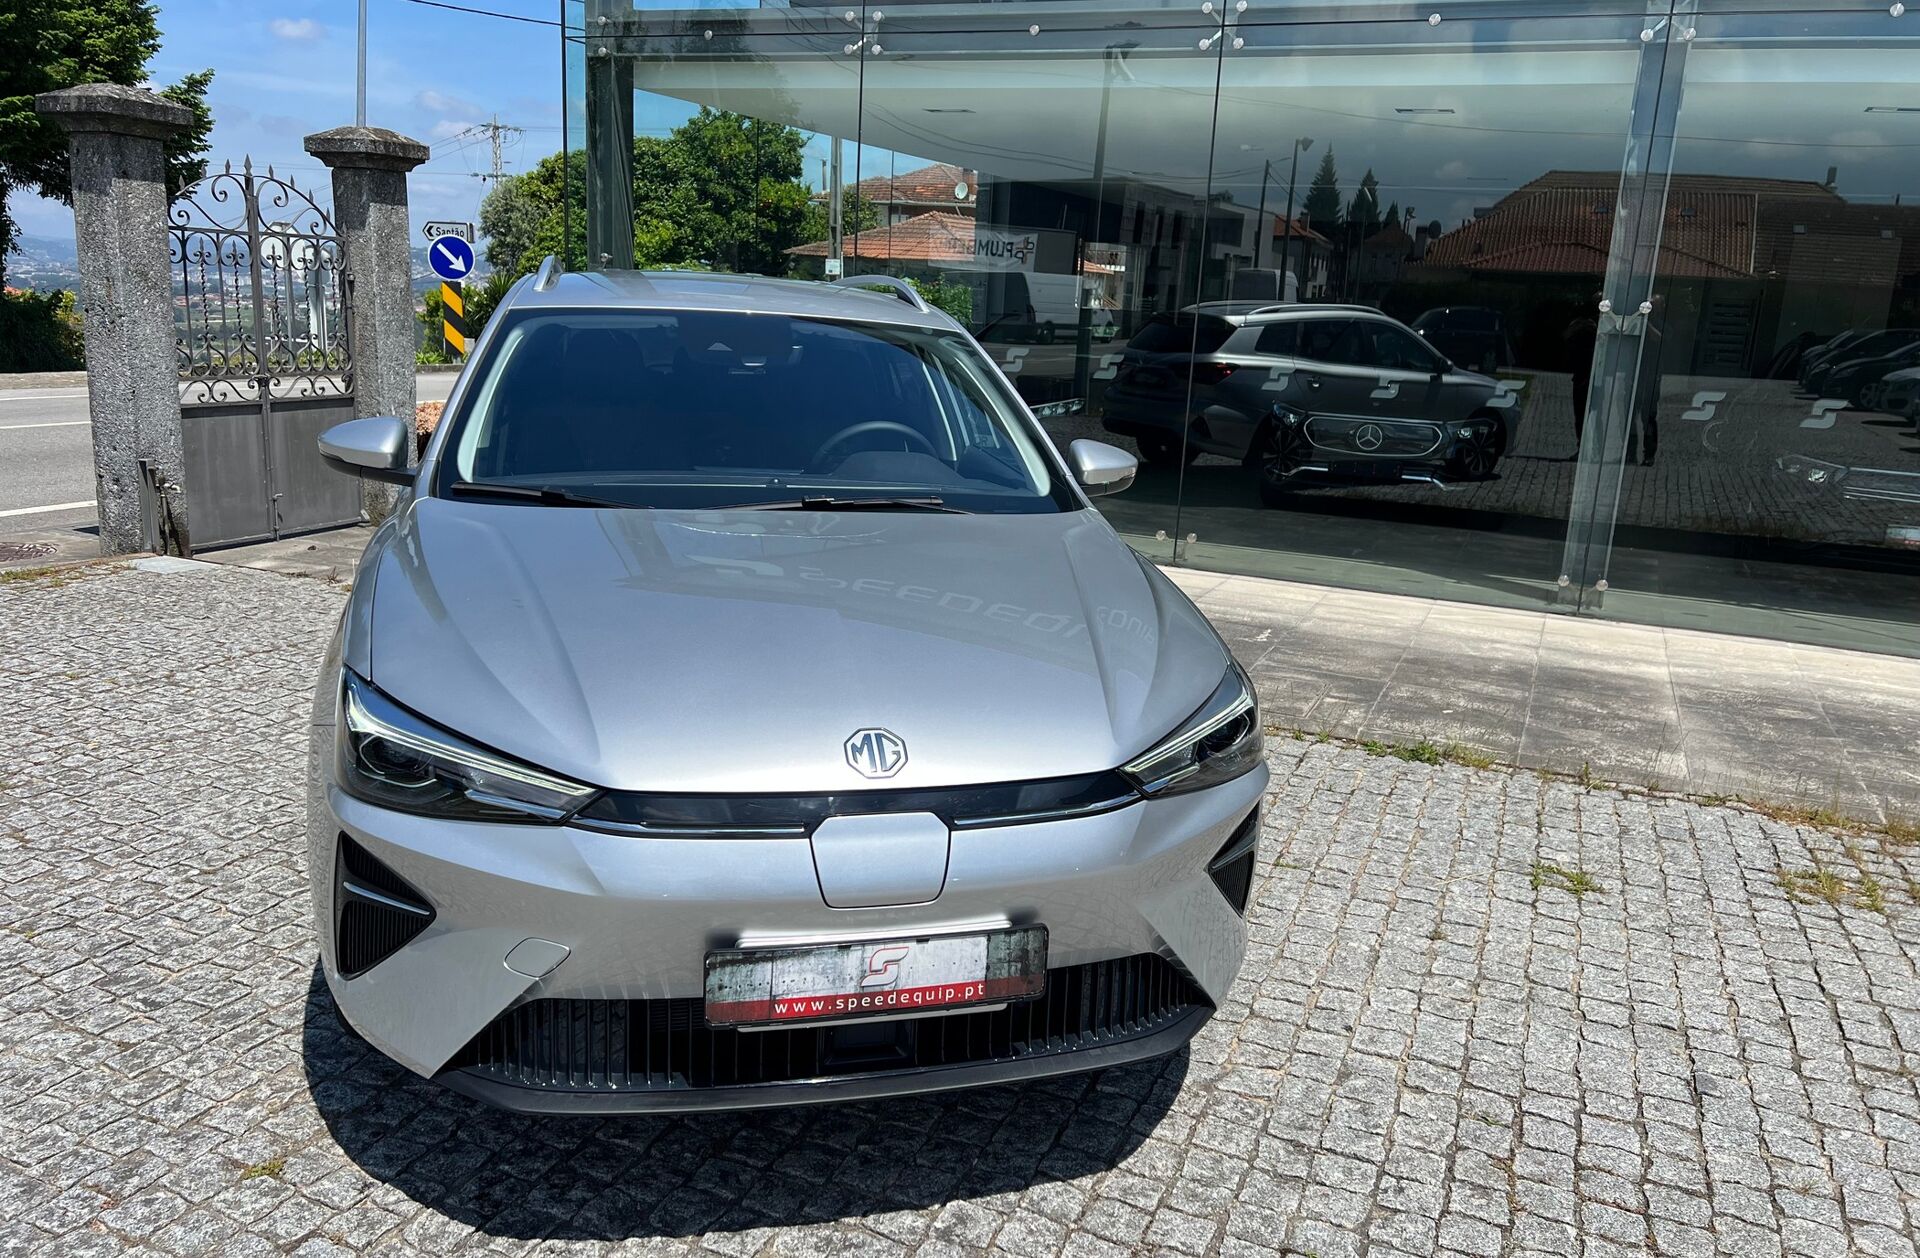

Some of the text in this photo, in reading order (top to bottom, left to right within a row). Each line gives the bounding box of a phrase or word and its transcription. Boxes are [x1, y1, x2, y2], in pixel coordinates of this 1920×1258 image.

[435, 227, 465, 237] Santão
[850, 732, 902, 774] MG
[774, 983, 985, 1014] www.speedequip.pt
